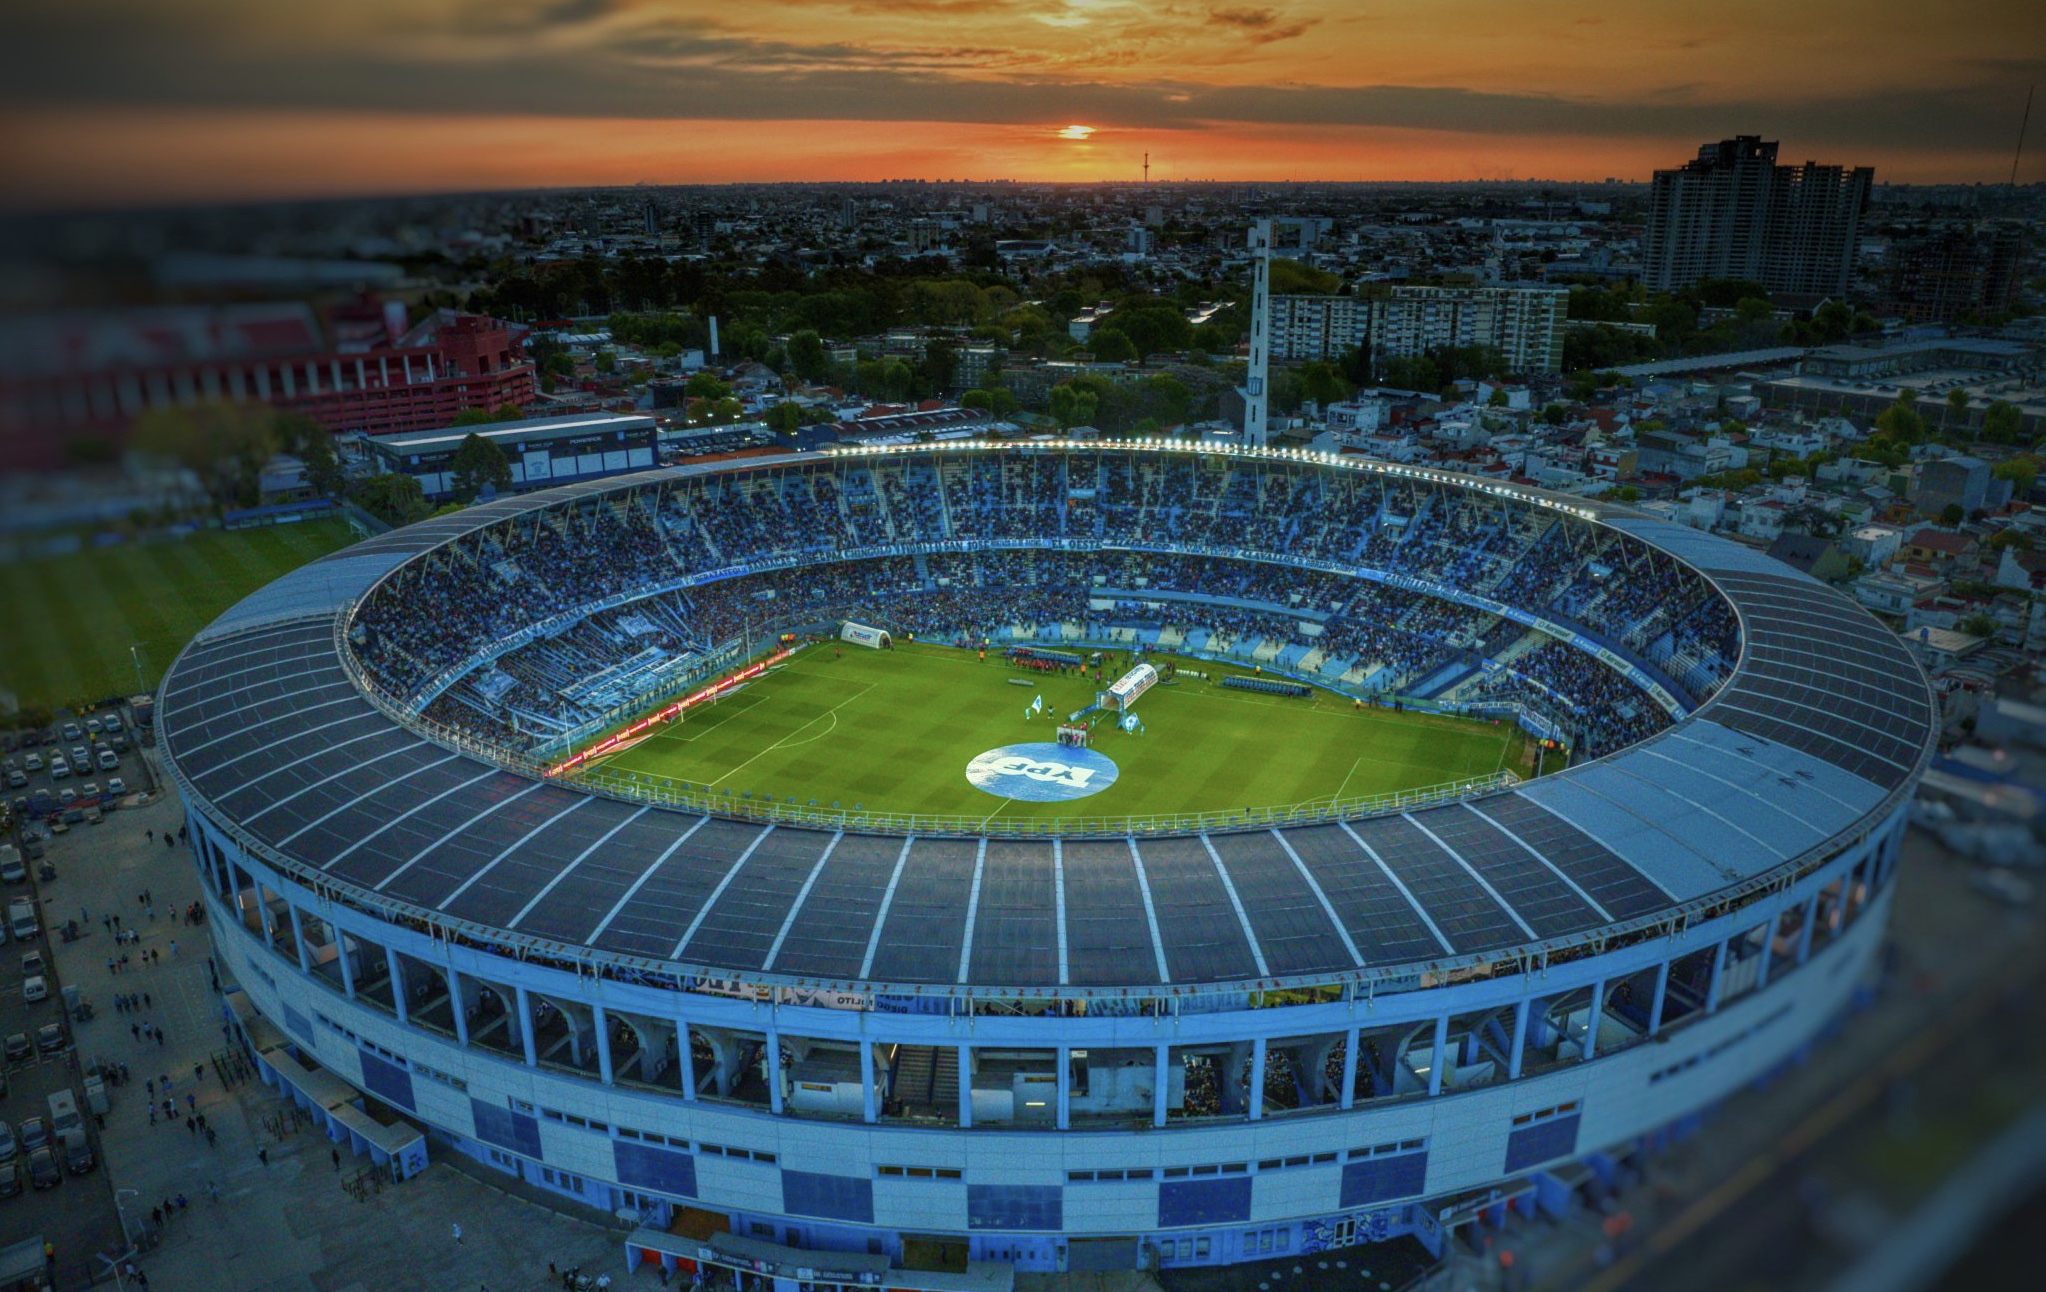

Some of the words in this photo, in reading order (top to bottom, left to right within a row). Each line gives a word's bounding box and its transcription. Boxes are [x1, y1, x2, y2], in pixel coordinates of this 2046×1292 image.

[944, 541, 962, 552] SAN
[967, 540, 990, 551] JOSE
[1052, 539, 1064, 550] EL
[1069, 539, 1102, 550] OESTE
[844, 545, 891, 559] CHINGOLO
